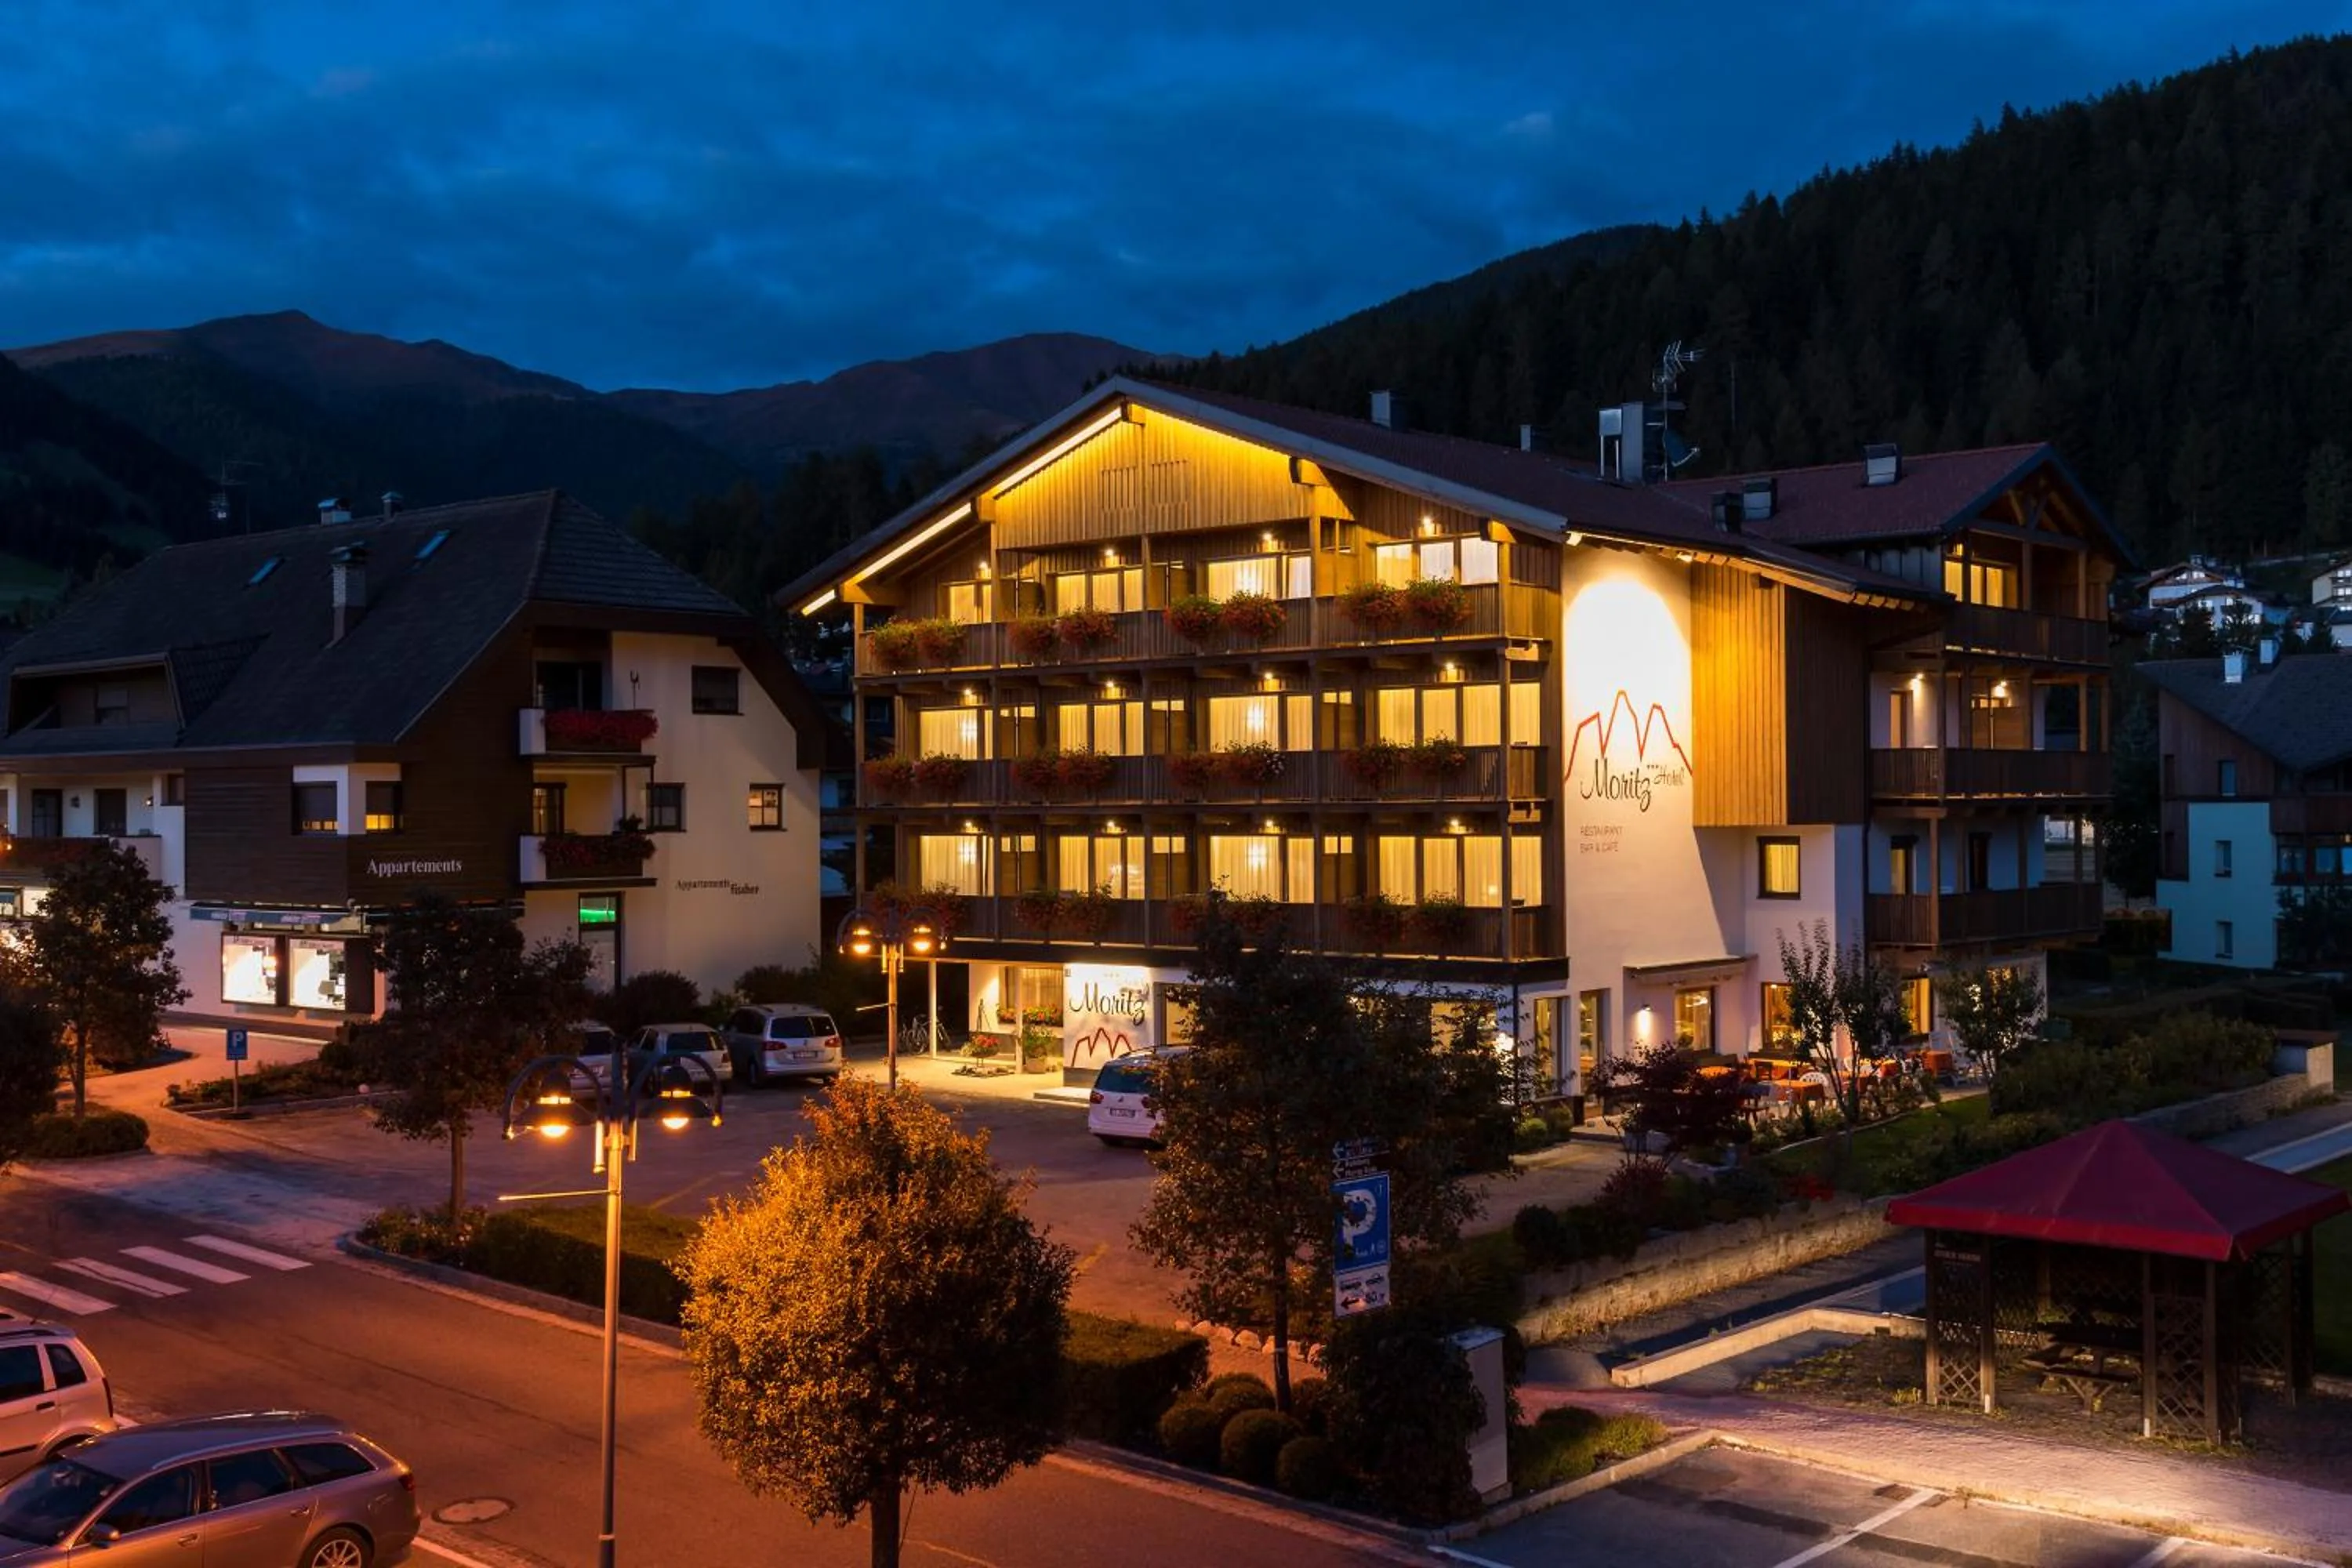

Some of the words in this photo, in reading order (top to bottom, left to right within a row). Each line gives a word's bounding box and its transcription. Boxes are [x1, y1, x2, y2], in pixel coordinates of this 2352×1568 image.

[1580, 758, 1651, 813] Moritz
[366, 858, 463, 878] Appartements
[1069, 982, 1146, 1026] Moritz
[232, 1031, 245, 1047] P
[1342, 1189, 1377, 1248] P
